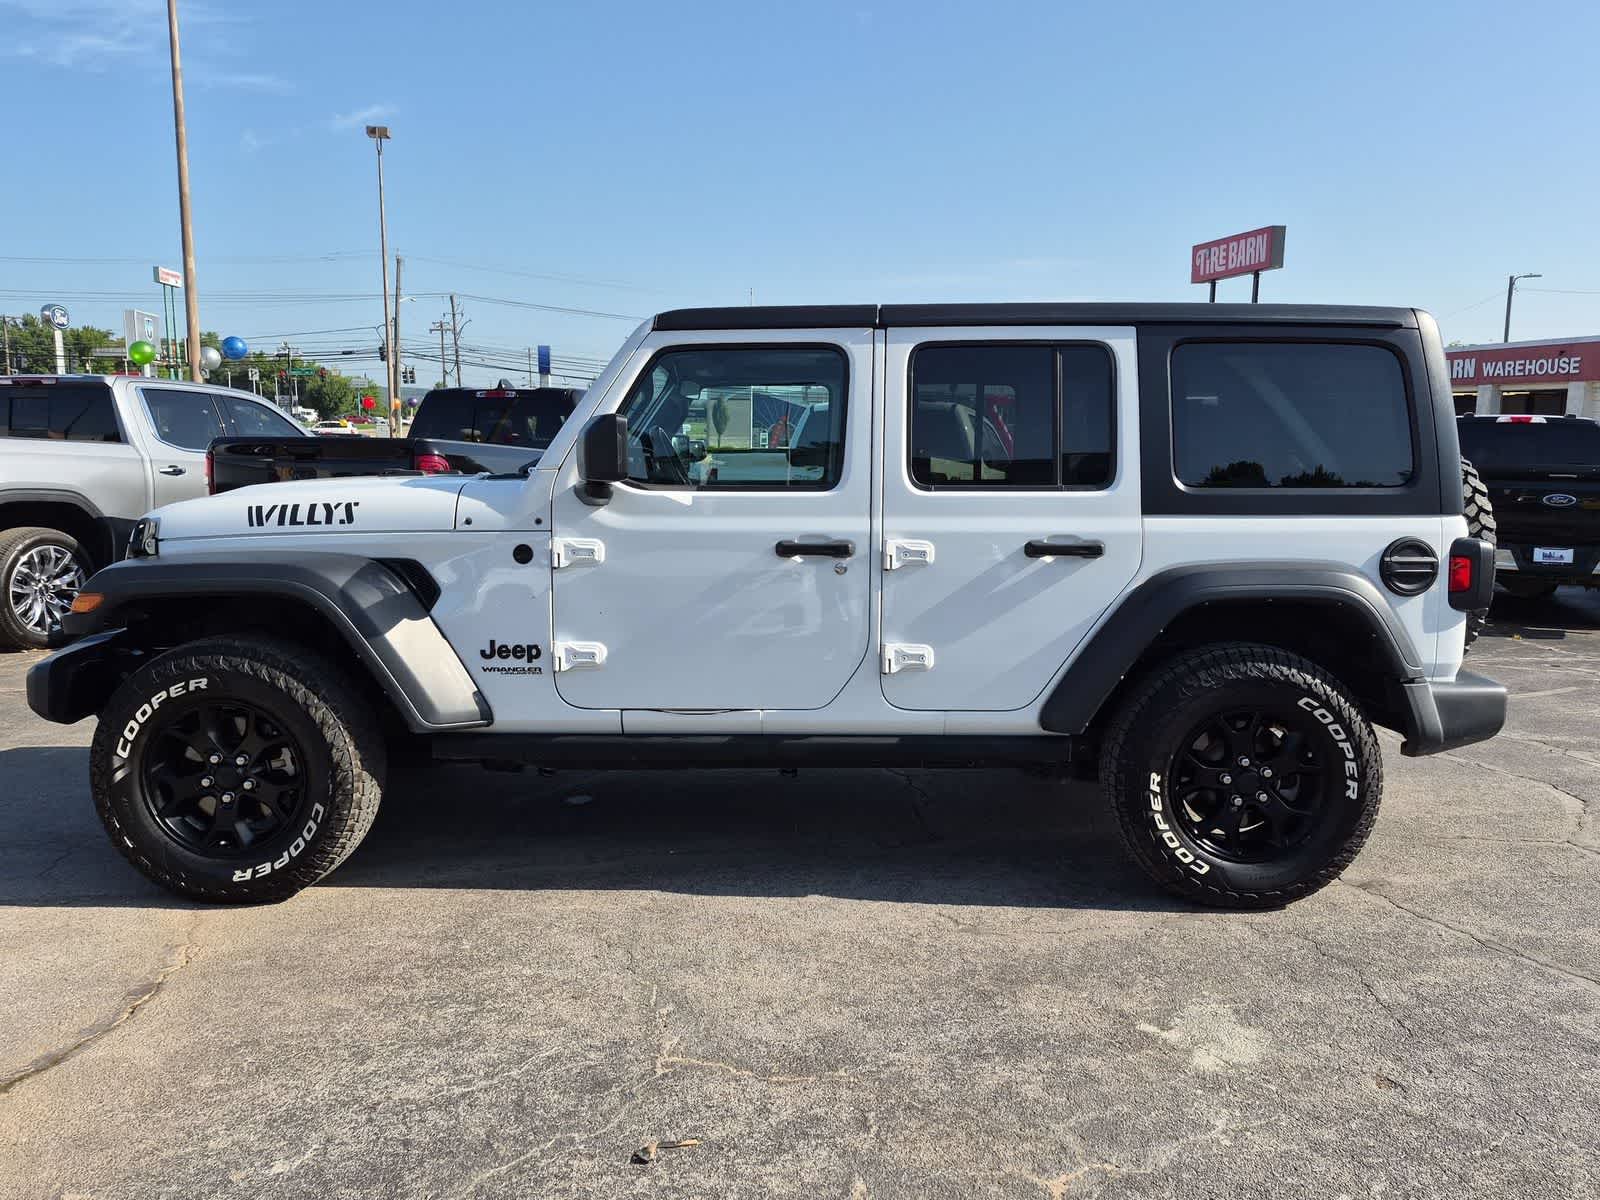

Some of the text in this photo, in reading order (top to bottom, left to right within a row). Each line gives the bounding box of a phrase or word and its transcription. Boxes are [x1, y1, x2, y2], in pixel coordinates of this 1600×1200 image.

[1228, 233, 1268, 270] BARN
[1482, 357, 1581, 377] WAREHOUSE
[247, 502, 360, 527] WILLYS
[480, 639, 542, 663] Jeep
[116, 677, 209, 759] COOPER
[1297, 696, 1359, 800] COOPER
[232, 802, 325, 882] COOPER
[1150, 772, 1210, 875] COOPER
